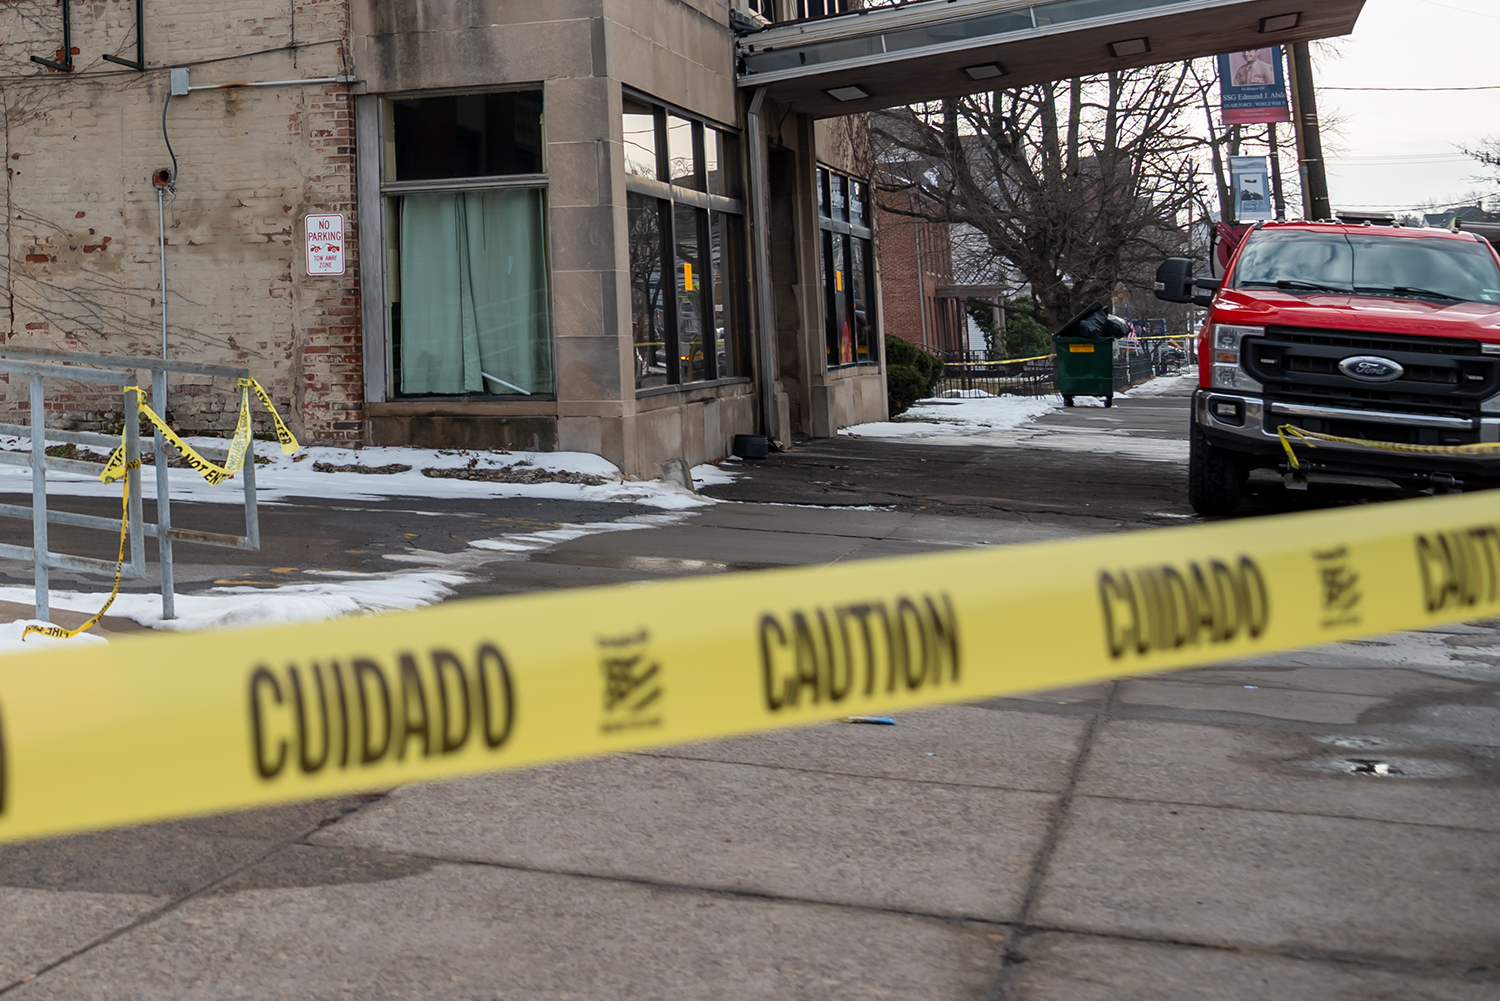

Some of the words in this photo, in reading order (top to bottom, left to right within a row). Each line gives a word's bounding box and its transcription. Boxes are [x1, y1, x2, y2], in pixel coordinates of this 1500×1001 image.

[1238, 92, 1263, 100] Edmund
[318, 220, 330, 230] NO
[308, 231, 341, 241] PARKING
[1355, 361, 1387, 375] Ford
[1098, 553, 1270, 661] CUIDADO
[757, 591, 963, 713] CAUTION
[248, 639, 517, 783] CUIDADO
